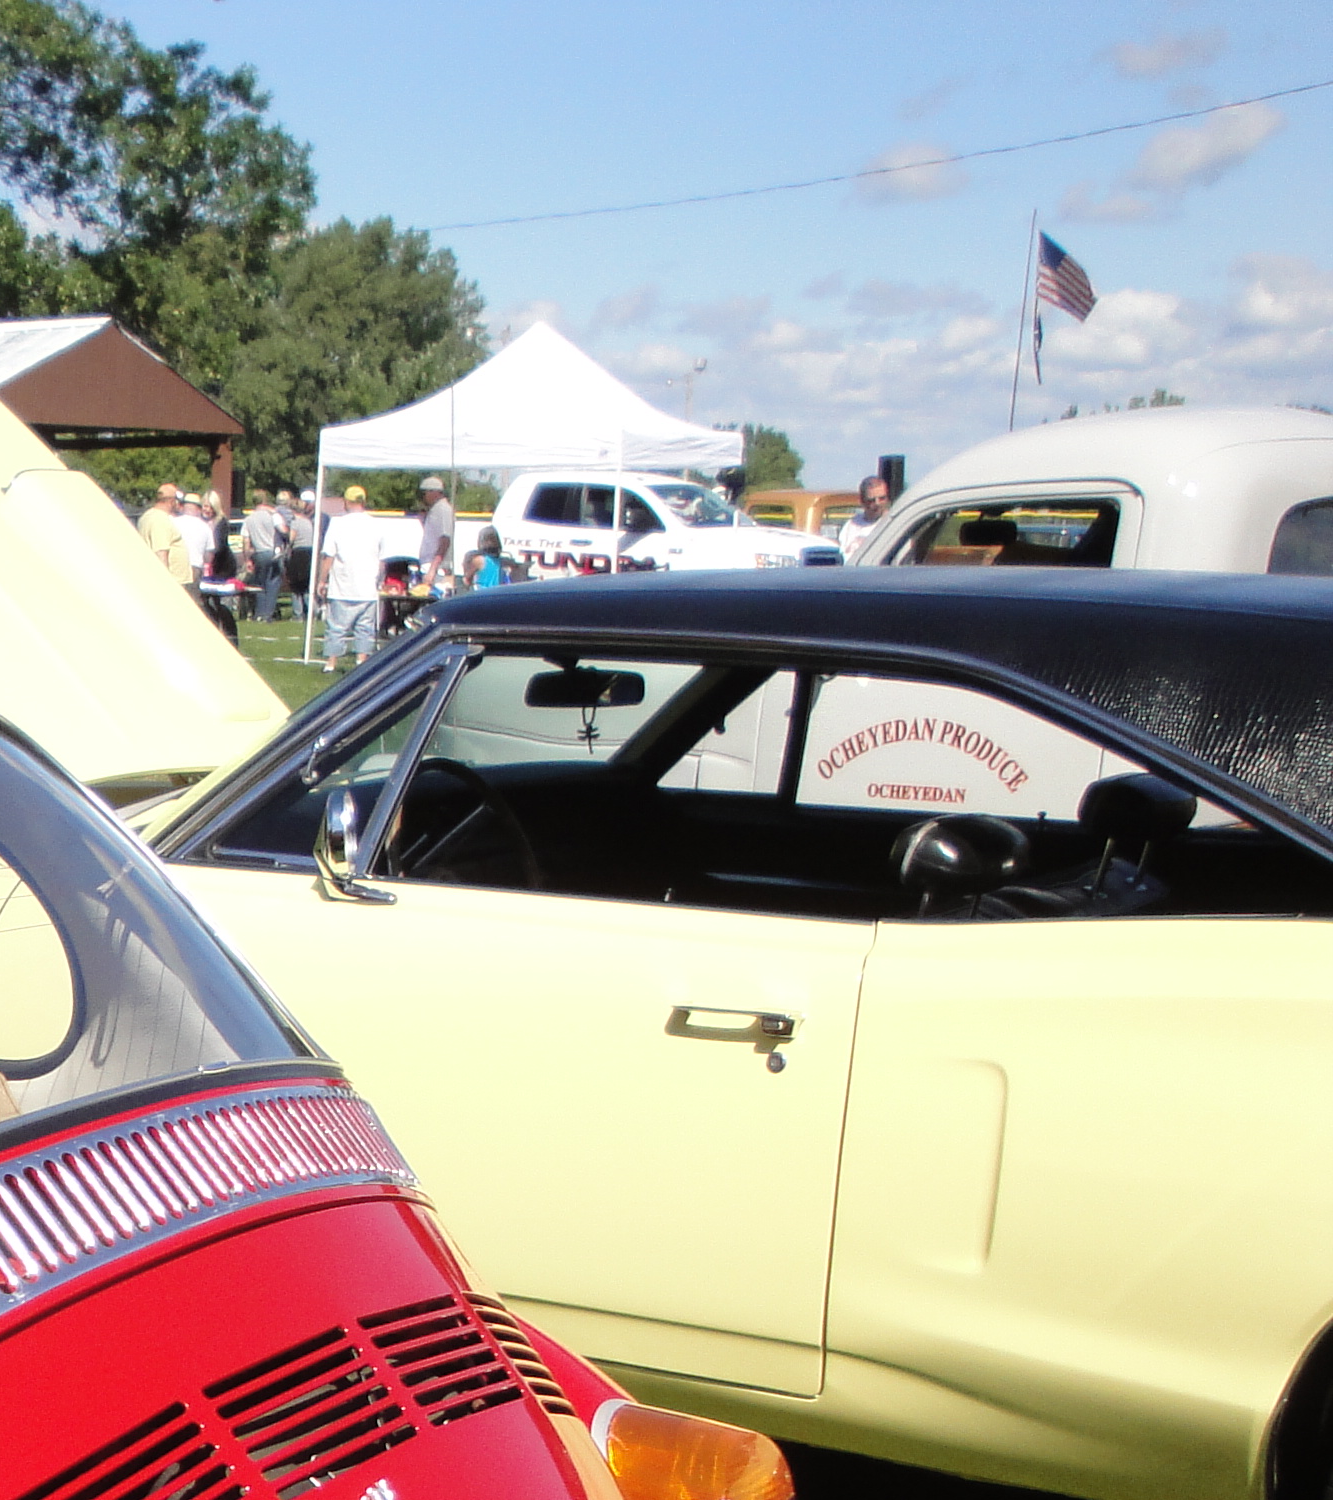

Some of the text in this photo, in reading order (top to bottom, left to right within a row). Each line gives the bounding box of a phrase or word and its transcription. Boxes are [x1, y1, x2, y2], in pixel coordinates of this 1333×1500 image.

[817, 718, 1030, 793] OCHEYEDAN PRODUCE
[867, 783, 966, 804] OCHEYEDAN
